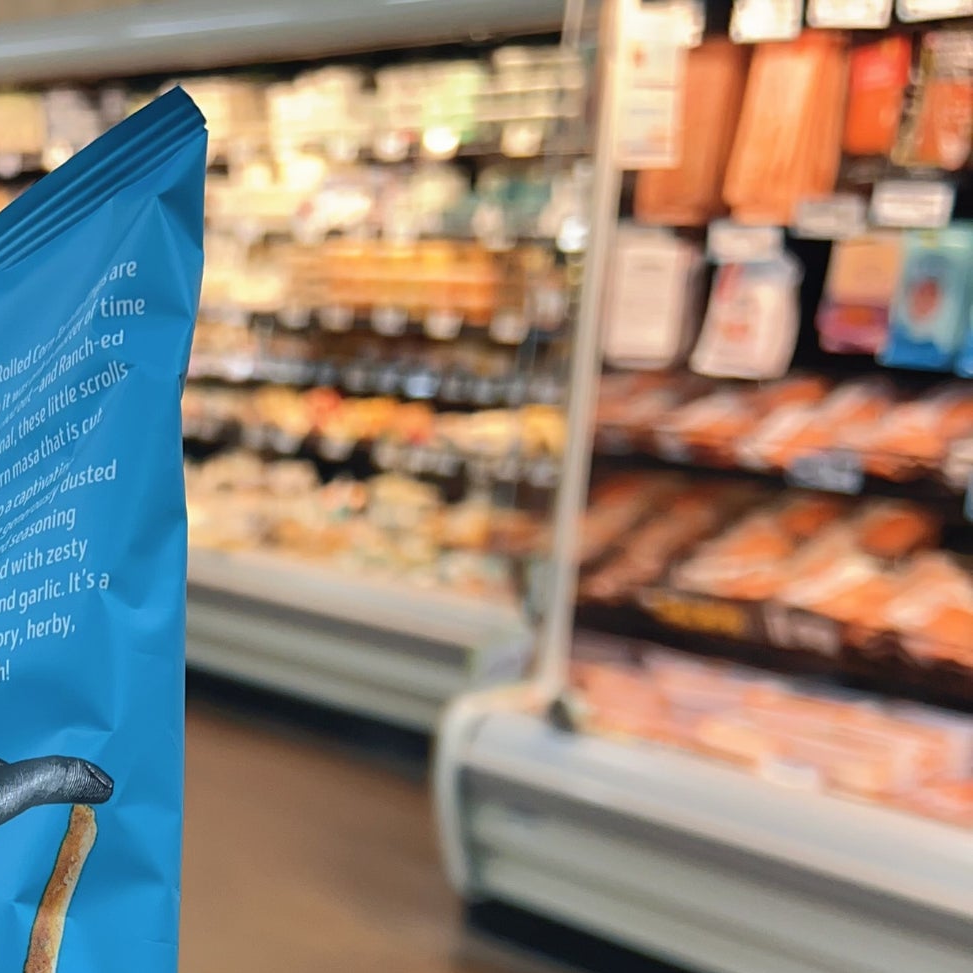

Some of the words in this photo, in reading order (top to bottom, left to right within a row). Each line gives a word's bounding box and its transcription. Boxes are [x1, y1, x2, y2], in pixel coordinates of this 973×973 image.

[108, 260, 137, 281] are
[2, 391, 12, 411] it
[100, 295, 145, 318] time
[58, 329, 124, 377] Ranch-ed
[18, 407, 46, 440] these
[47, 385, 77, 418] little
[79, 360, 129, 398] scrolls
[12, 449, 40, 479] masa
[41, 427, 66, 458] that
[66, 421, 80, 443] is
[82, 407, 104, 434] cut
[4, 499, 13, 514] a
[13, 457, 75, 506] captivatin
[60, 458, 117, 494] dusted
[8, 507, 76, 548] seasoning
[11, 547, 43, 576] with
[46, 537, 88, 563] zesty
[18, 578, 66, 614] garlic.
[68, 568, 95, 594] It's
[99, 572, 110, 590] a
[27, 612, 76, 640] herby,
